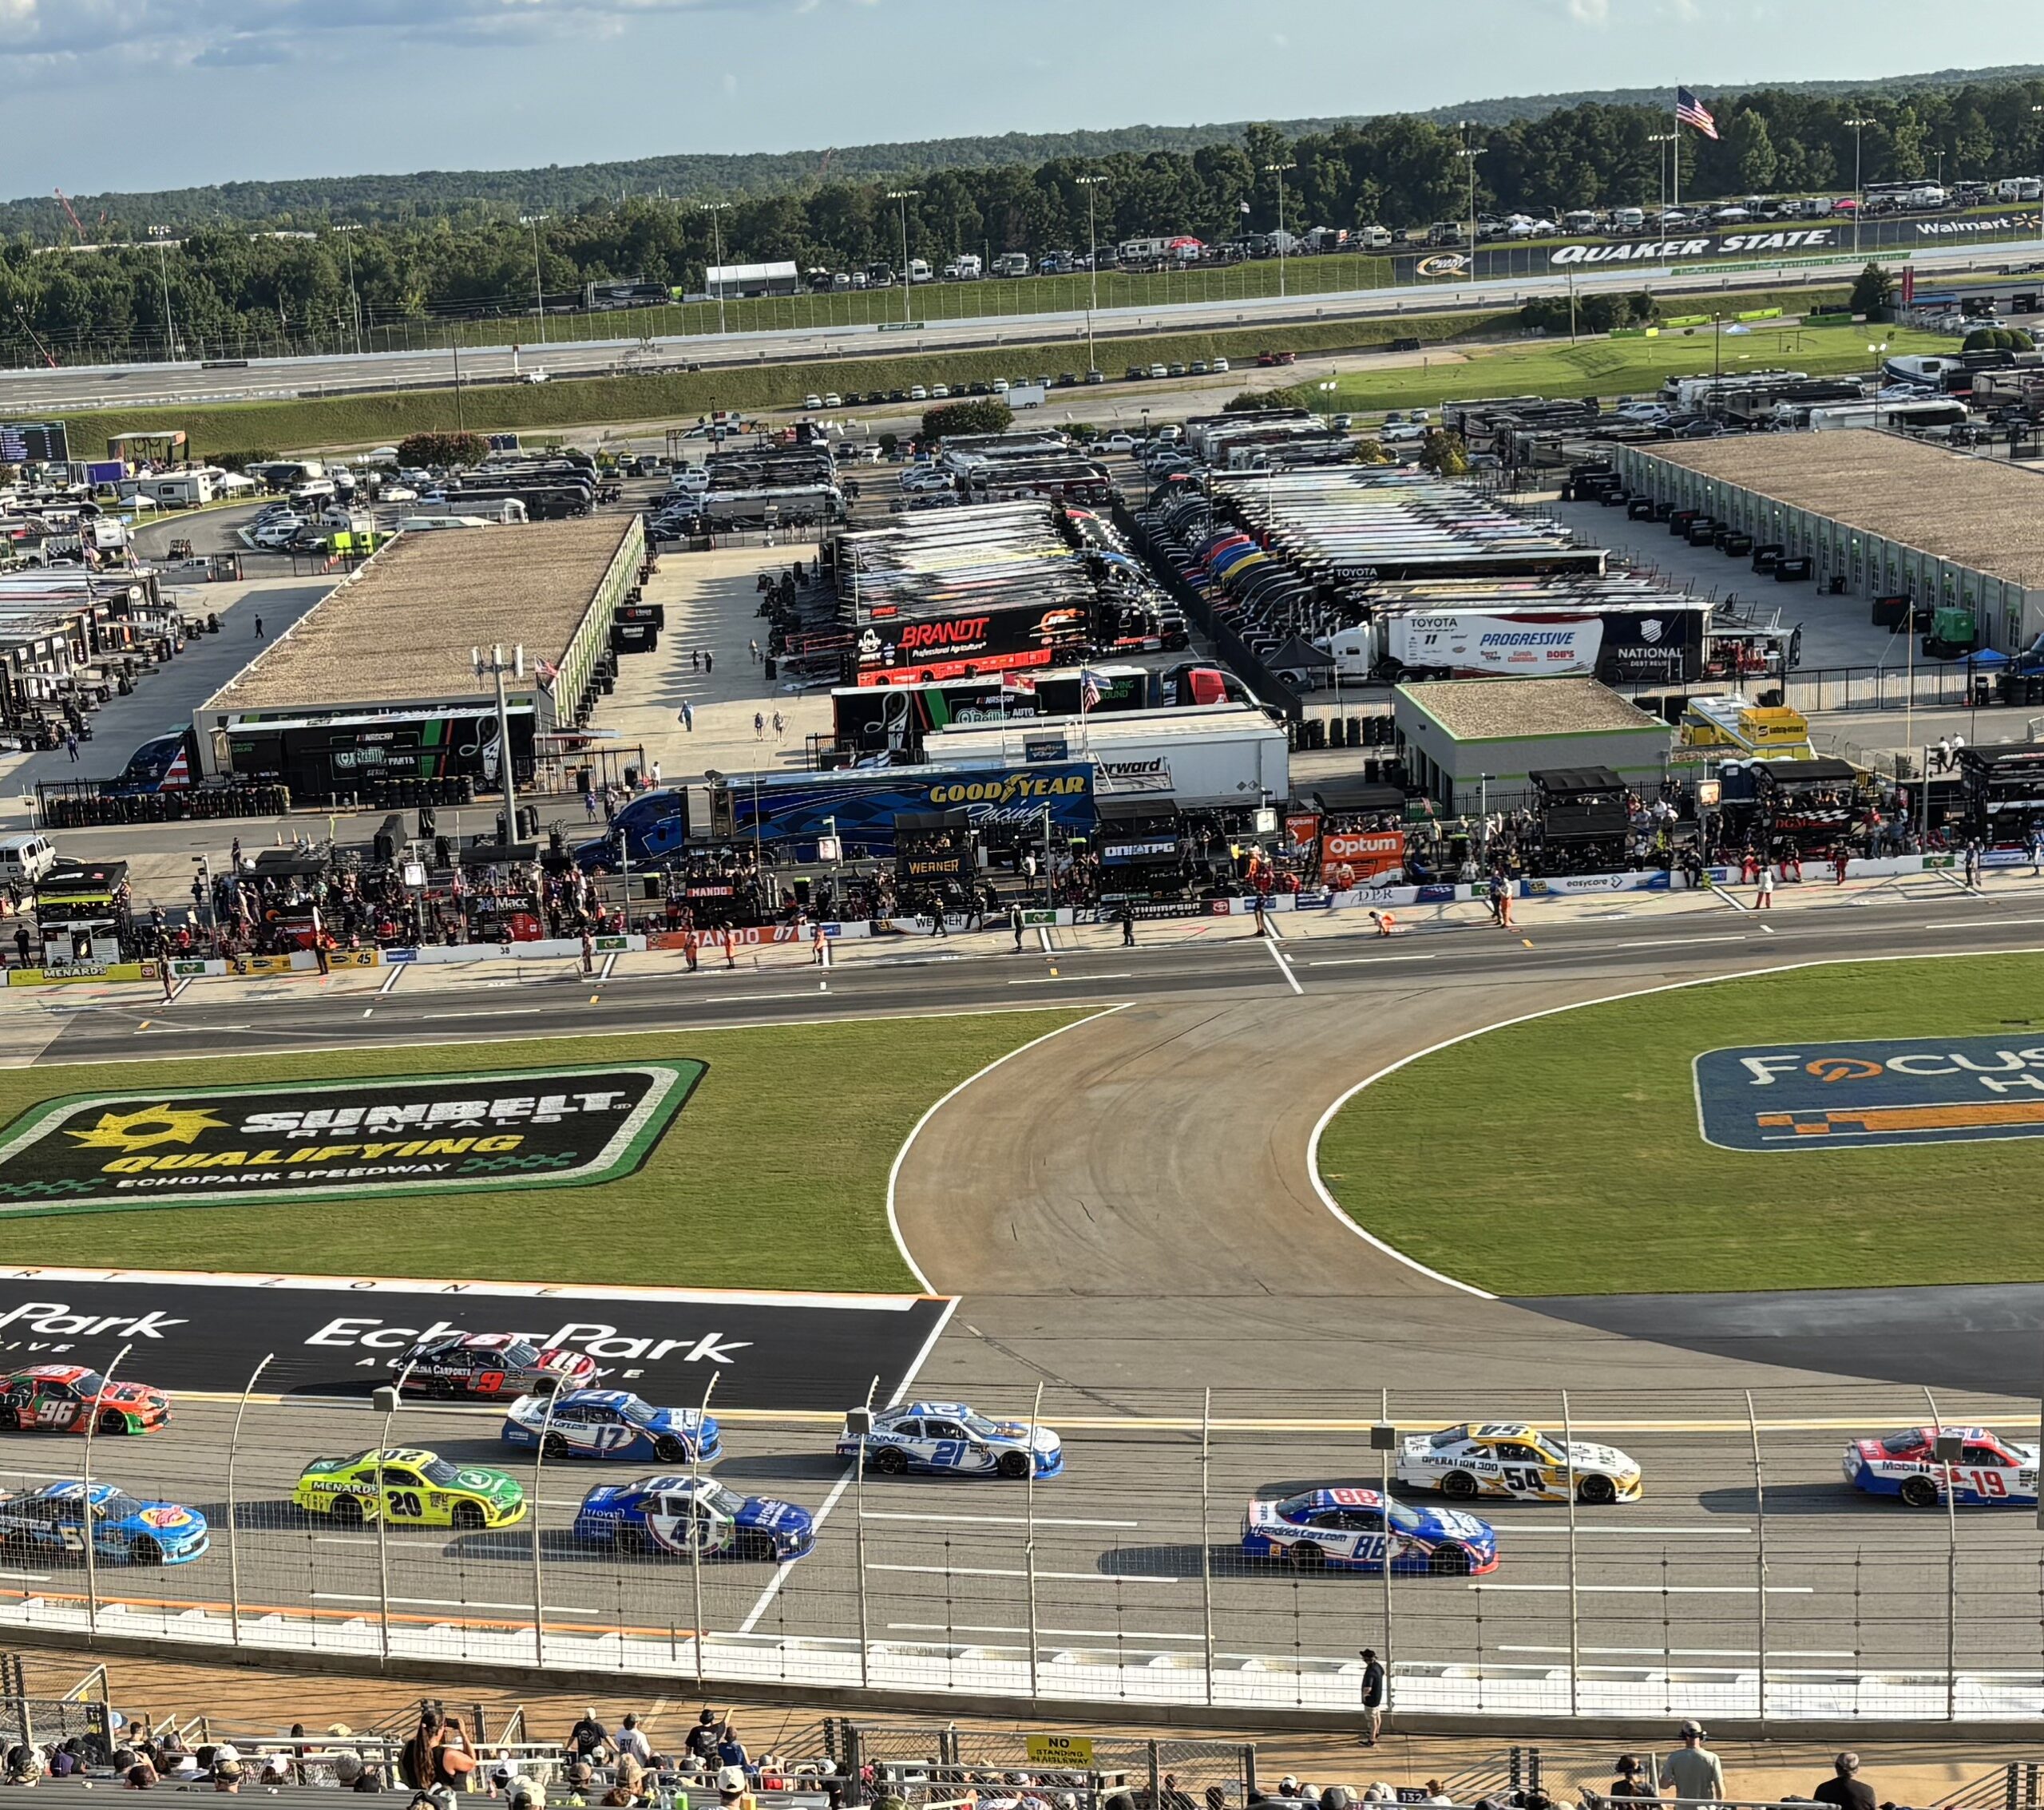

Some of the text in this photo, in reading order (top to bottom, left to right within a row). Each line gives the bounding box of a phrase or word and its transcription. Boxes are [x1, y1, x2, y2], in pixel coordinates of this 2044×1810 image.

[1916, 218, 2011, 234] Walmart
[1551, 238, 1709, 264] QUAKER
[1337, 568, 1377, 577] TOYOTA
[897, 617, 989, 648] BRANDT
[1411, 618, 1457, 627] TOYOTA
[1424, 635, 1438, 644] 11
[1480, 632, 1576, 646] PROGRESSIVE
[1618, 648, 1682, 659] NATIONAL
[1012, 707, 1035, 717] AUTO
[930, 774, 1086, 803] GOODYEAR
[1329, 838, 1396, 856] Optum
[909, 859, 960, 874] WERNER
[773, 927, 795, 941] 07
[43, 966, 107, 979] MENARDS
[240, 1091, 628, 1134] SUNBELT
[287, 1114, 564, 1140] RENTALS
[101, 1135, 527, 1174] QUALIFYING
[116, 1162, 453, 1191] ECHOPARK SPEEDWAY
[476, 1370, 505, 1392] 9
[40, 1400, 76, 1423] 96
[594, 1425, 626, 1450] 17
[930, 1440, 970, 1467] 21
[1422, 1455, 1476, 1471] OPERATION
[1503, 1467, 1546, 1492] 54
[1970, 1470, 2010, 1498] 19
[387, 1491, 423, 1517] 20
[1048, 1737, 1070, 1749] NO
